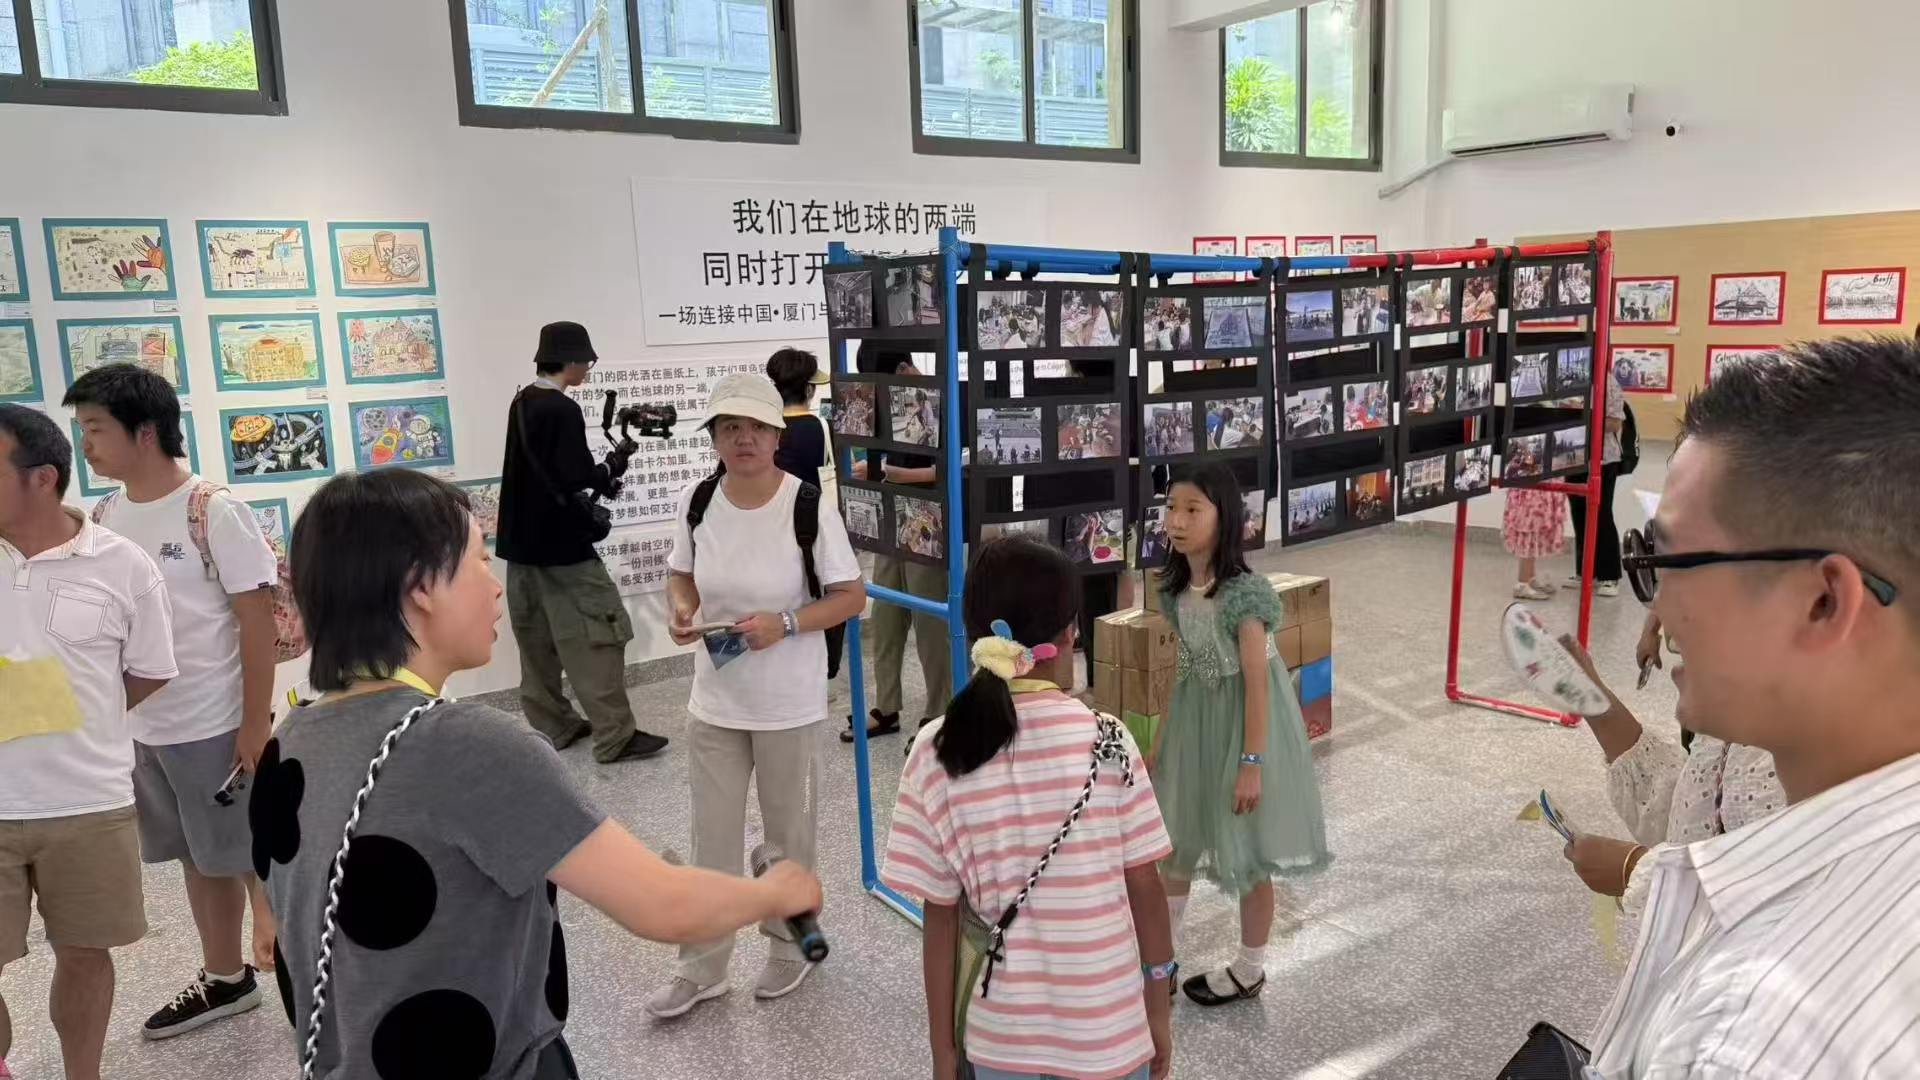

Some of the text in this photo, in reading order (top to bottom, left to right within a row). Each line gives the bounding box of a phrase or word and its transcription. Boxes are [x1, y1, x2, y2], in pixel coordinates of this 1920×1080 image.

[732, 198, 976, 235] 我们在地球的两端
[703, 250, 828, 286] 同时打开
[569, 382, 711, 401] 方的梦而在地球的另一端，
